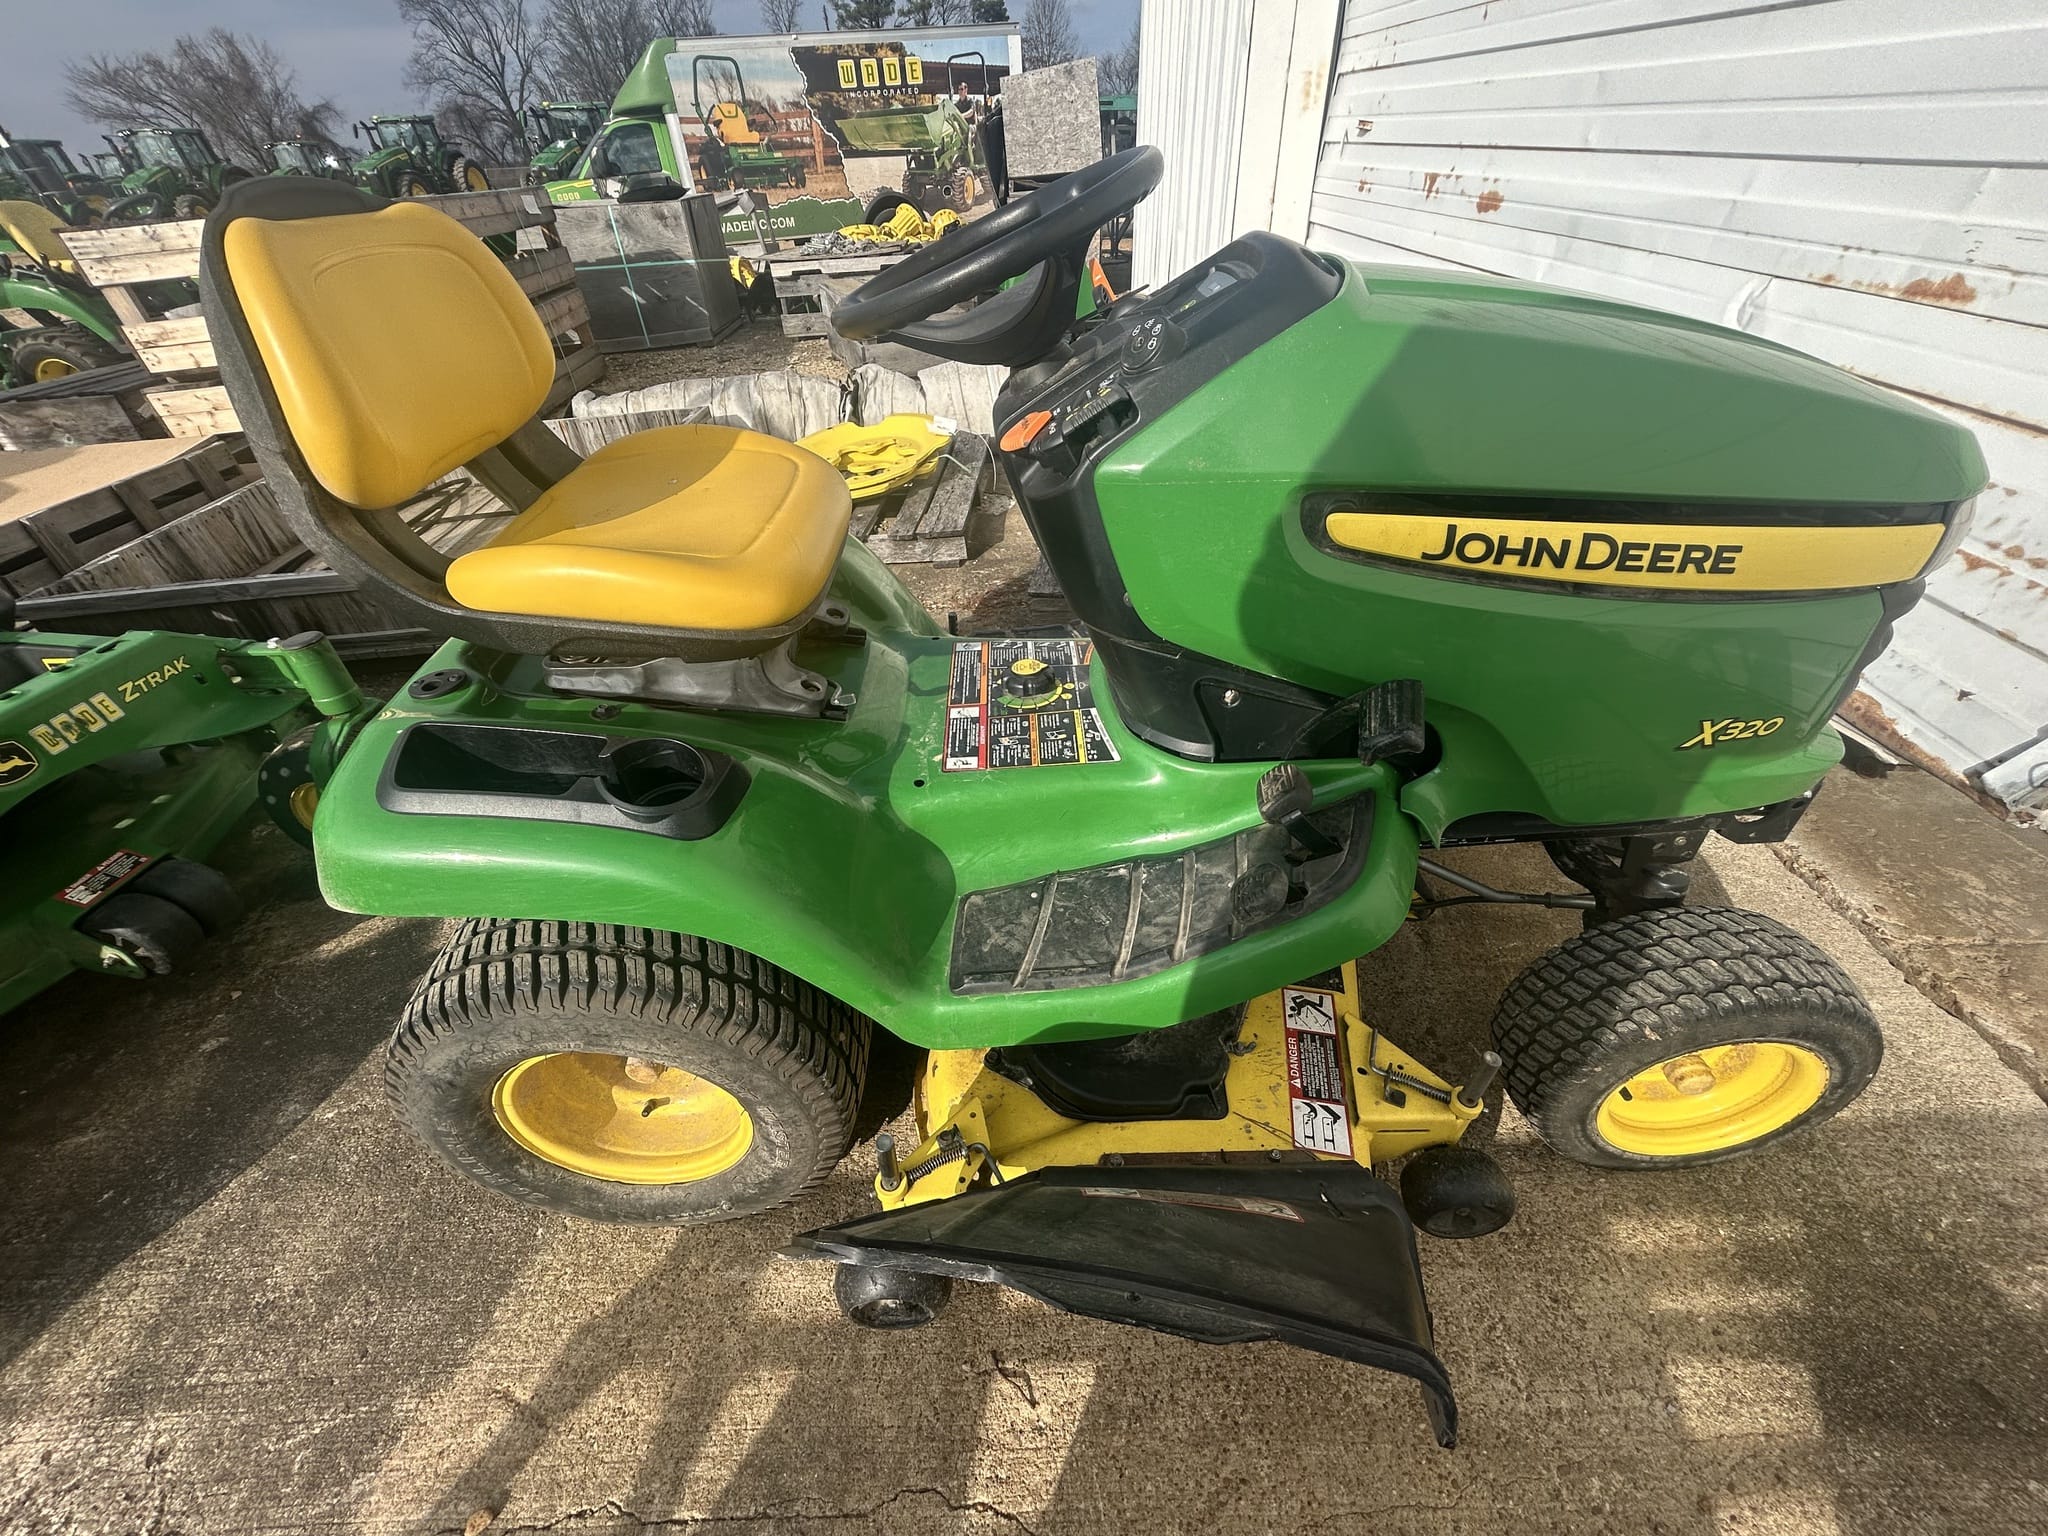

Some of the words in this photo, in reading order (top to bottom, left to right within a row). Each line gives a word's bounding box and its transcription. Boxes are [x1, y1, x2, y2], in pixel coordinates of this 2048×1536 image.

[839, 59, 921, 86] WADE
[846, 88, 919, 98] INCORPORATED
[721, 216, 795, 234] WADEINCCOM
[1421, 524, 1571, 569] JOHN
[1575, 532, 1743, 575] DEERE
[117, 655, 191, 703] ZTRAK
[1680, 717, 1785, 748] X320
[1288, 1037, 1300, 1077] DANGER
